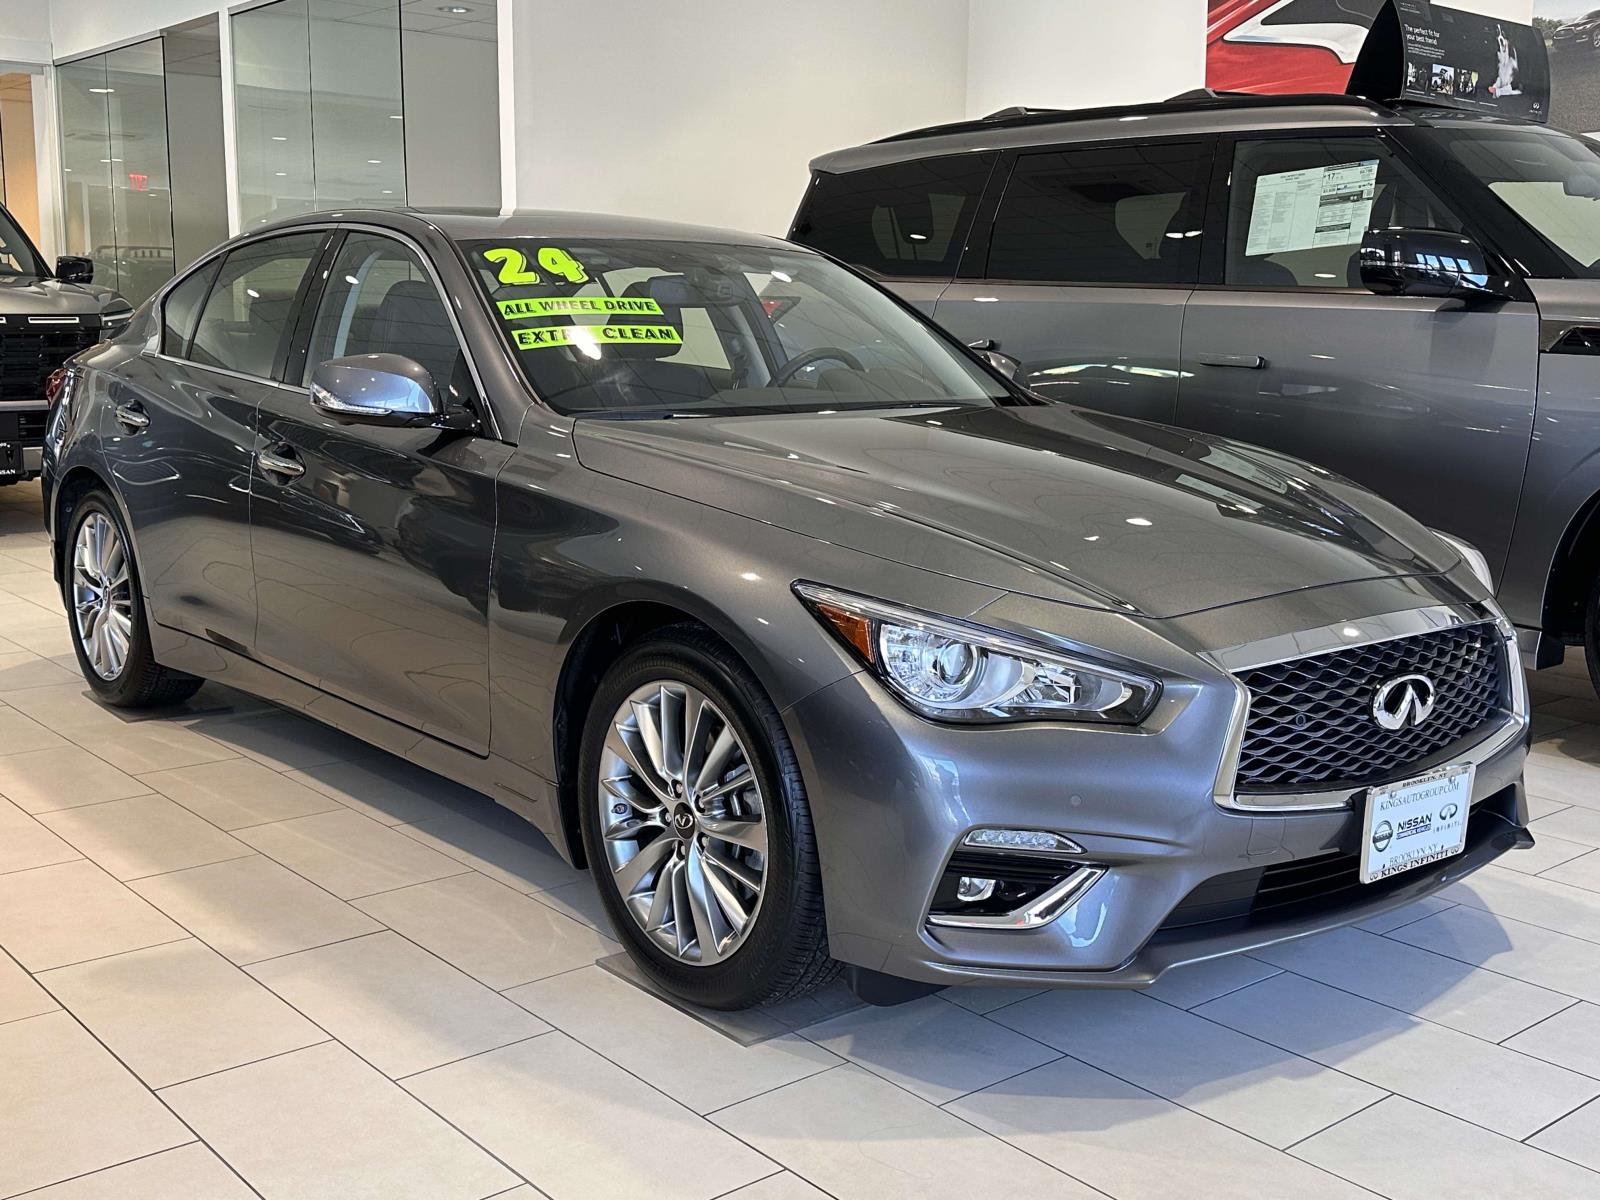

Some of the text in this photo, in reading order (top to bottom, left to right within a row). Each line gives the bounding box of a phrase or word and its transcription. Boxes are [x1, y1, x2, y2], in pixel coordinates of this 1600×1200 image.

[483, 247, 589, 285] 24
[503, 300, 657, 316] ALL WHEEL DRIVE
[517, 327, 675, 345] EXTR CLEAN
[1397, 813, 1433, 831] NISSAN
[1380, 849, 1449, 878] KINGS INFINITI
